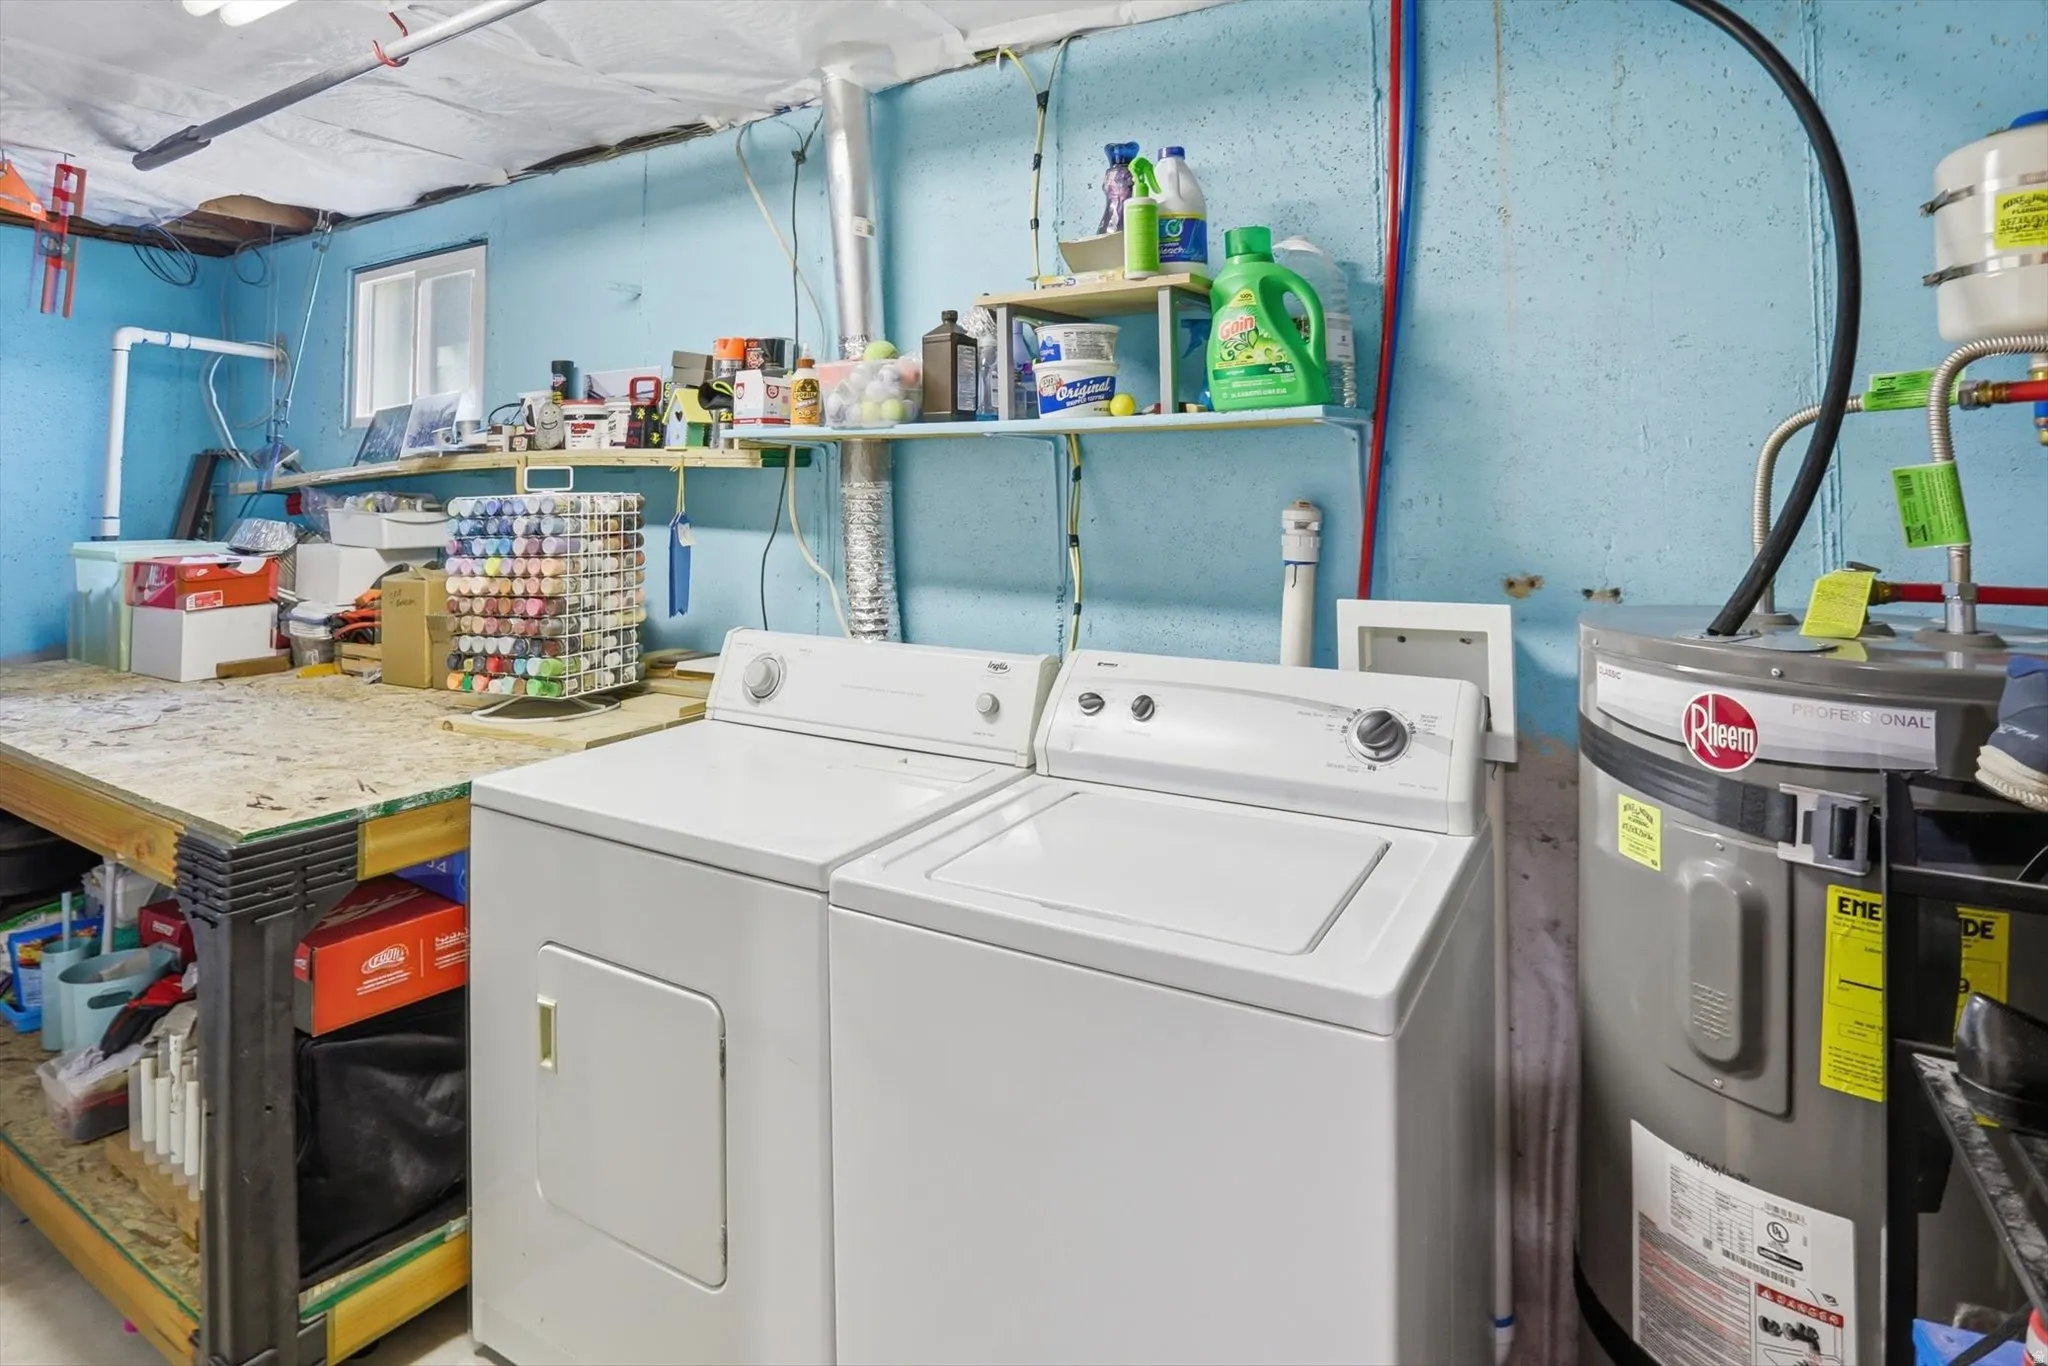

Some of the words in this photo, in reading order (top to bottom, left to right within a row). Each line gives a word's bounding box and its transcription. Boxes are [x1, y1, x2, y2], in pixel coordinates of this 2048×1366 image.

[1219, 316, 1256, 341] Gain
[1055, 376, 1112, 401] Original
[1689, 693, 1754, 758] Rheem
[1791, 702, 1931, 730] PROFESSIONAL
[1775, 1294, 1840, 1326] DANGER
